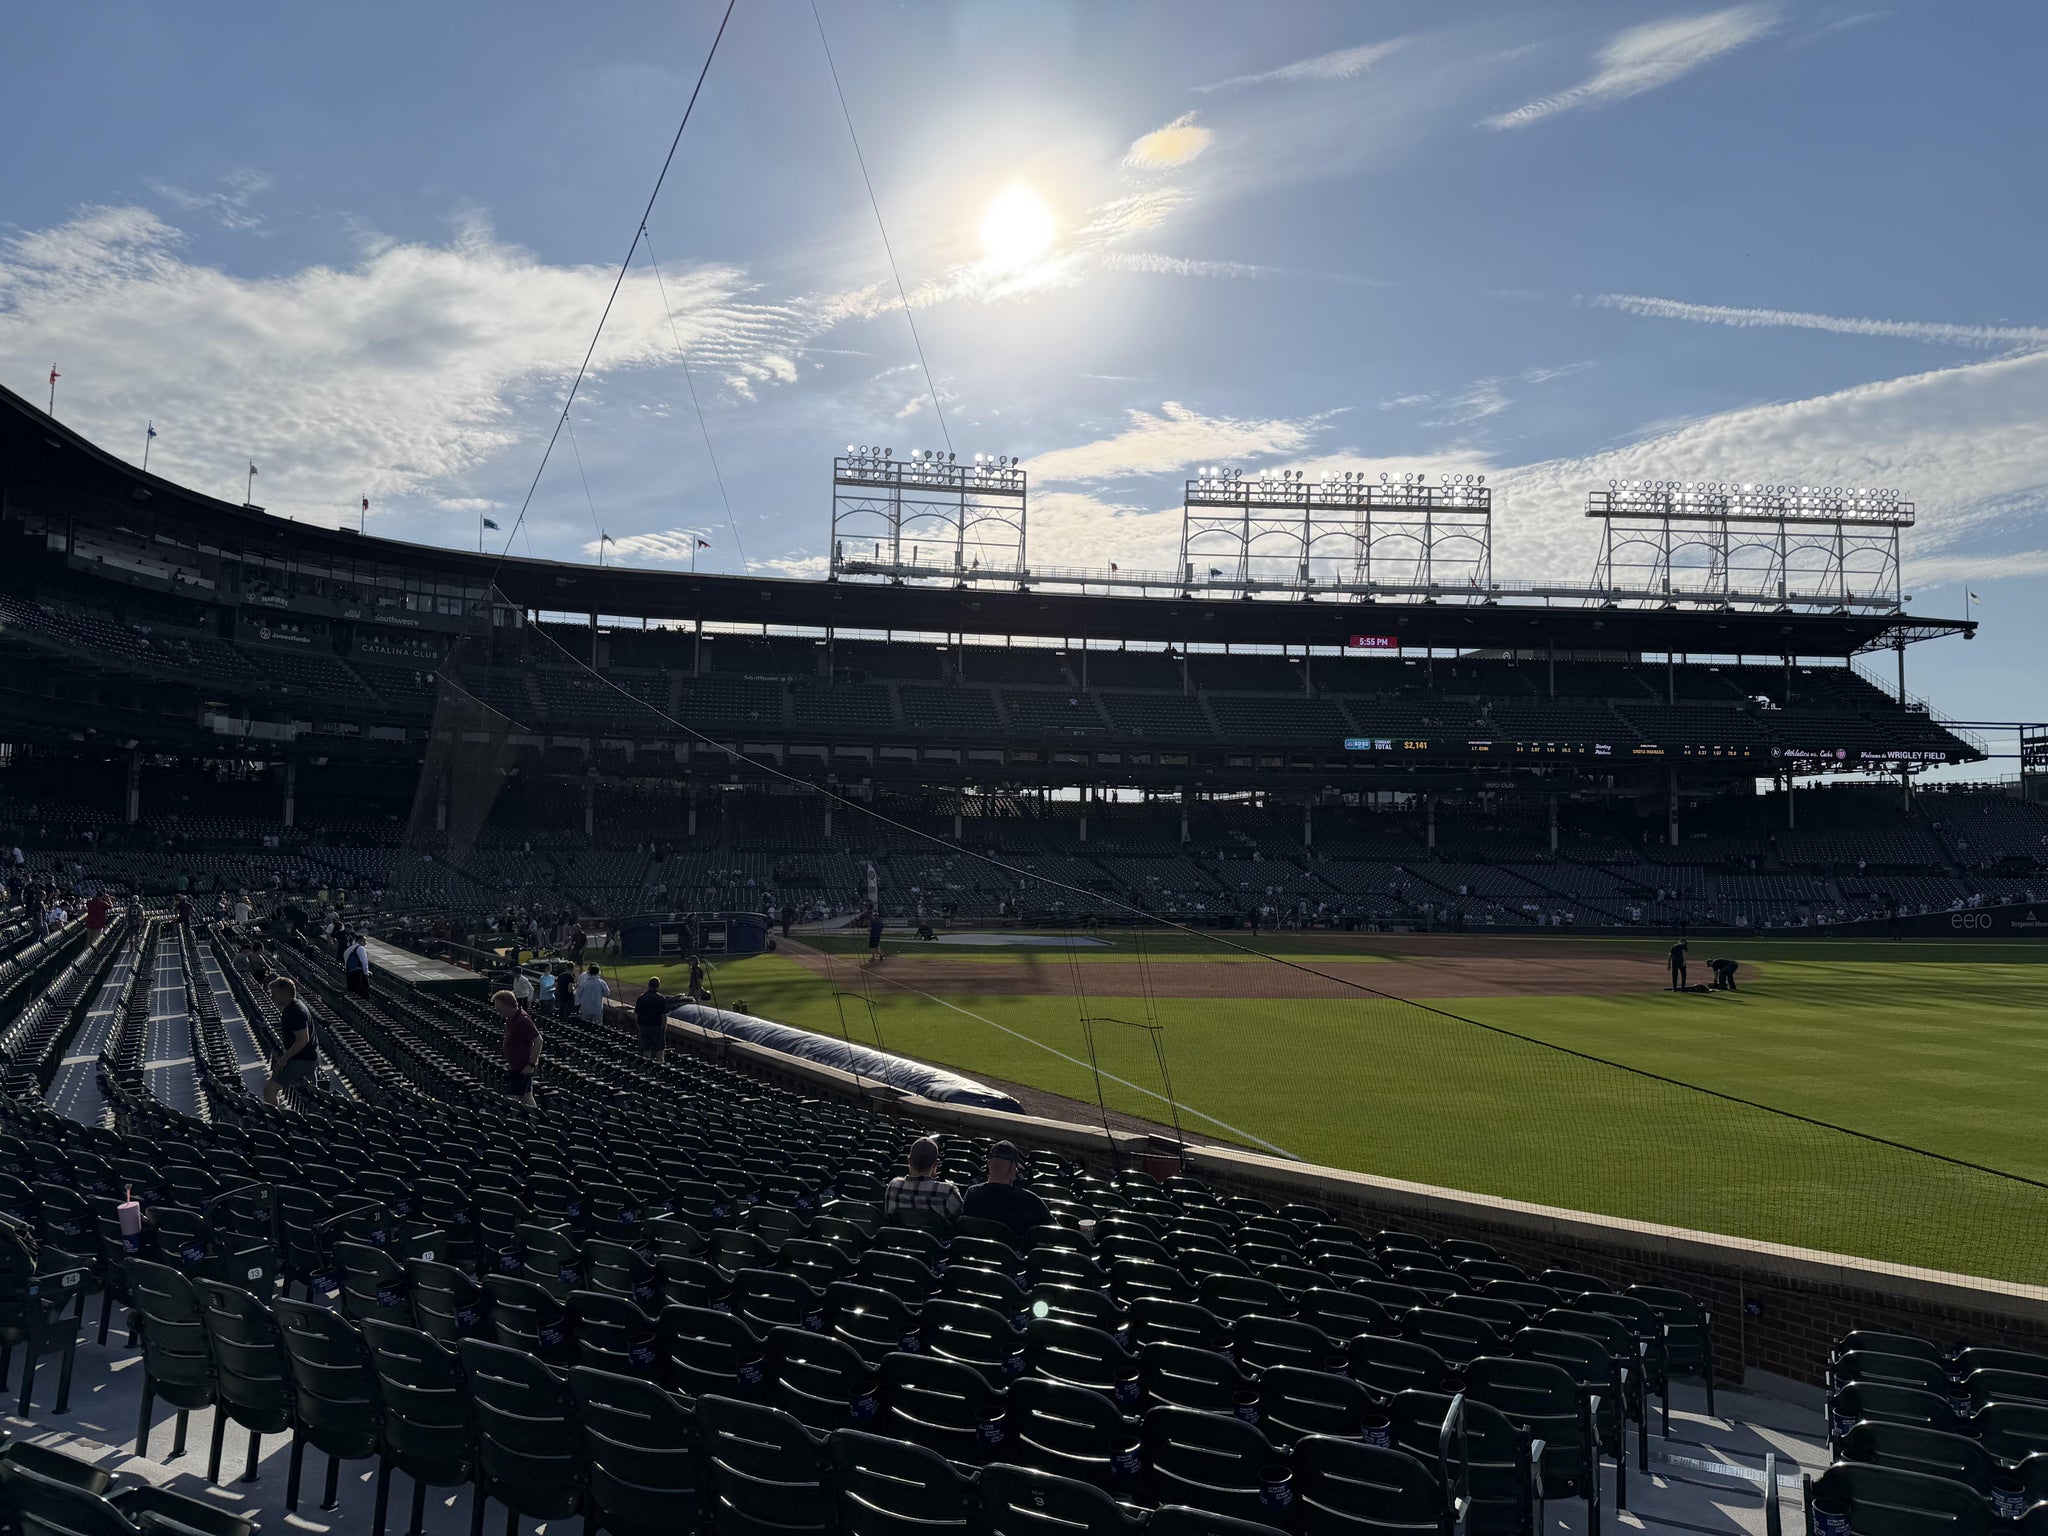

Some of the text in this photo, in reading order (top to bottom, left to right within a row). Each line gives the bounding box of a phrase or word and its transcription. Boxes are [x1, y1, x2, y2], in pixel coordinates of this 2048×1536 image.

[375, 614, 416, 626] Southwest
[1359, 638, 1388, 646] 5:55 PM
[361, 644, 438, 659] CATALINA CLUB
[1404, 741, 1427, 750] $2,141
[1784, 749, 1810, 757] Athletics
[1819, 749, 1833, 757] Cubs
[1887, 751, 1922, 759] WRIGLEY
[1923, 751, 1946, 760] FIELD
[1951, 913, 1992, 929] eero
[251, 1270, 261, 1278] 13
[66, 1275, 76, 1284] 14
[1034, 1496, 1045, 1507] 9
